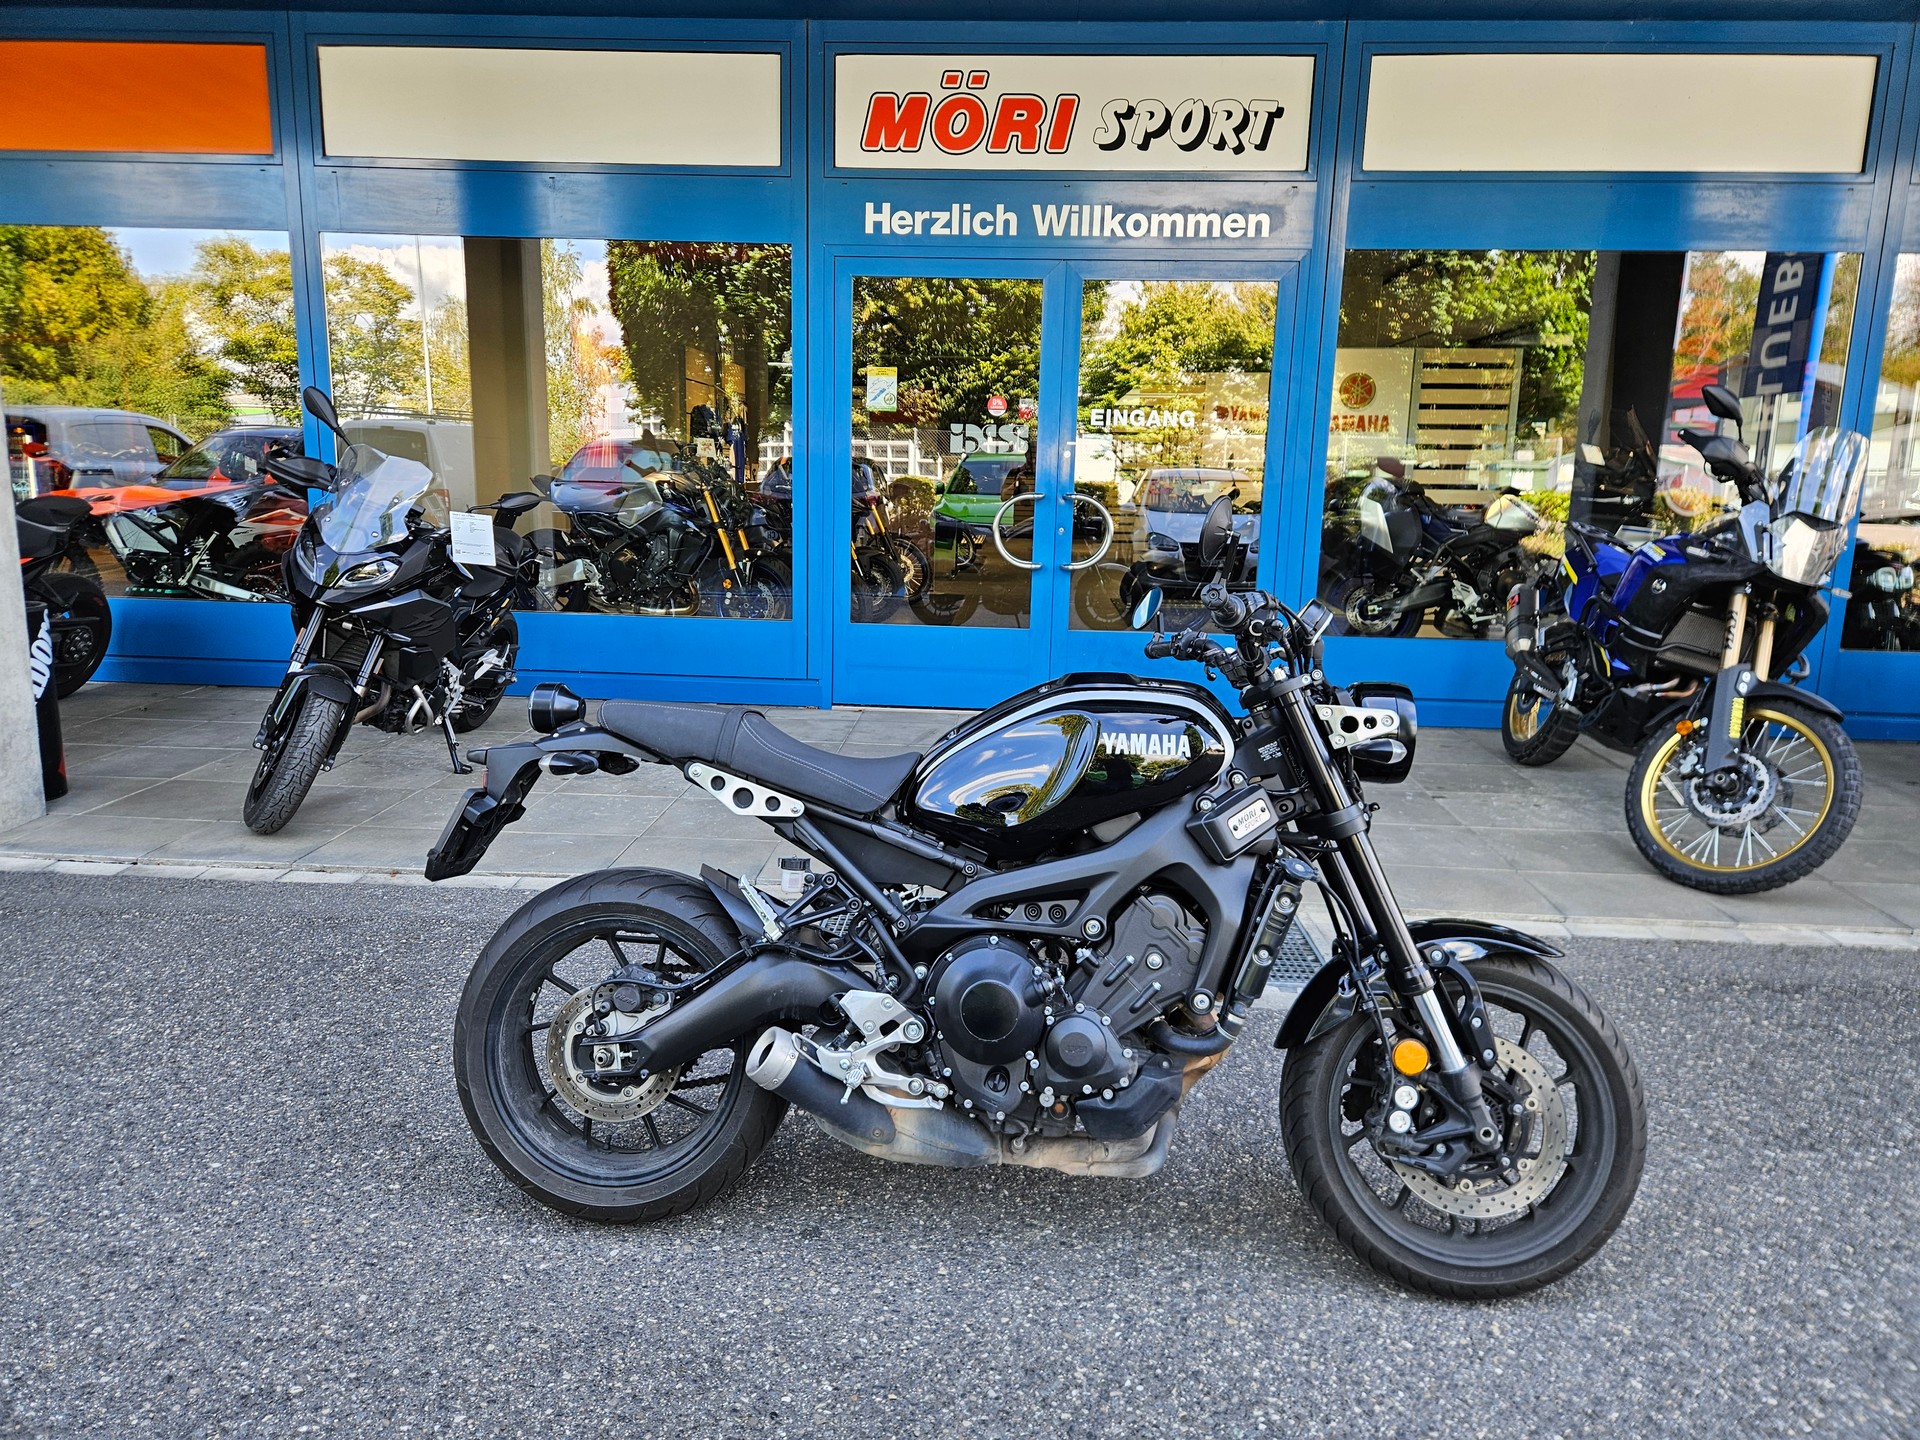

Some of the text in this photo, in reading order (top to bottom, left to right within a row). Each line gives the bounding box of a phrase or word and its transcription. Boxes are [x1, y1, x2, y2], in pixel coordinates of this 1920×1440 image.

[860, 70, 1284, 155] MÖRI SPORT
[864, 202, 1271, 238] Herzlich Willkommen
[992, 398, 1003, 406] 0%
[1090, 408, 1195, 428] EINGANG
[1329, 415, 1389, 432] AMAHA
[1102, 732, 1192, 758] YAMAHA
